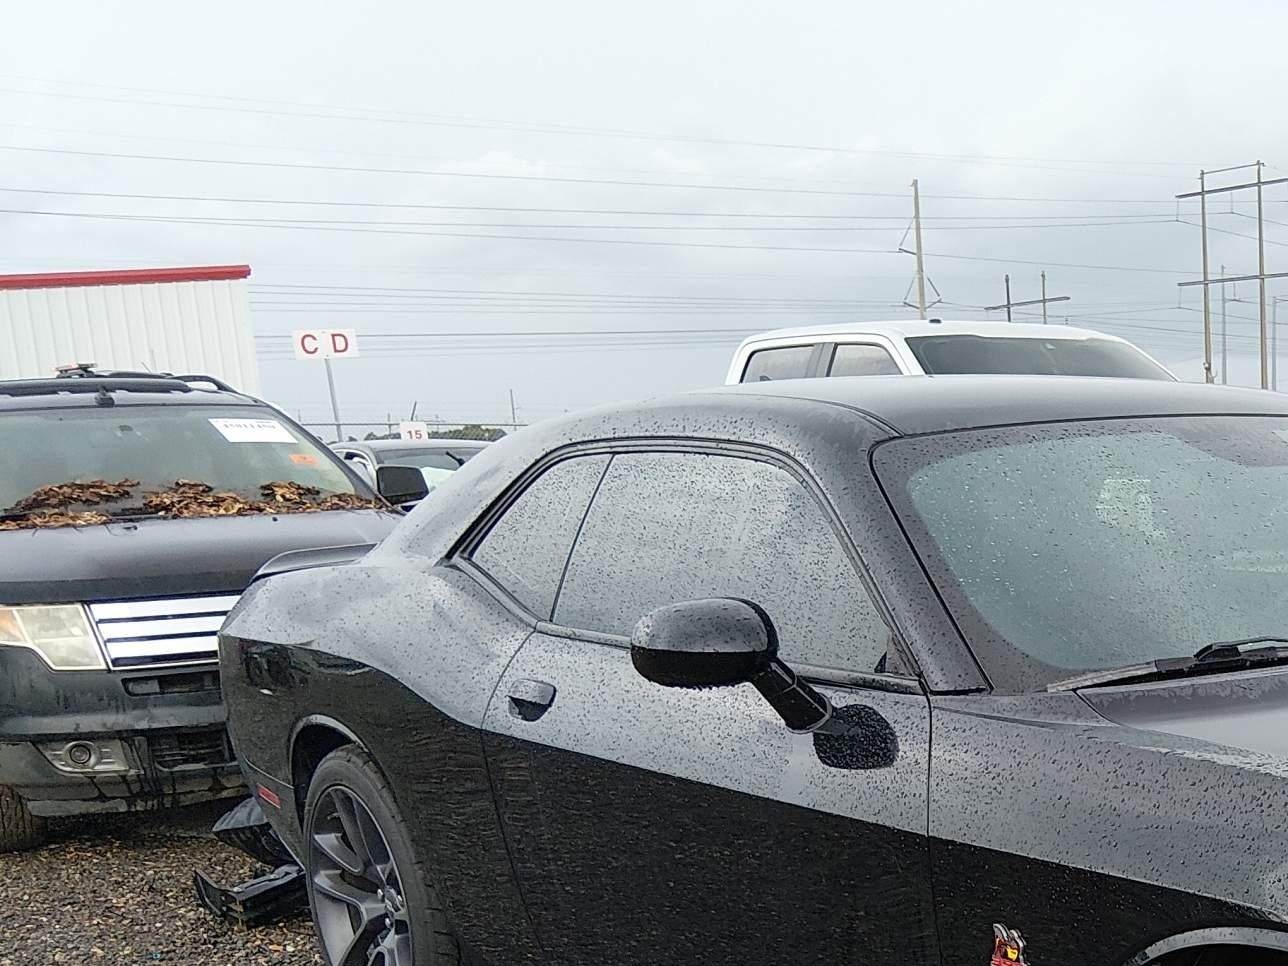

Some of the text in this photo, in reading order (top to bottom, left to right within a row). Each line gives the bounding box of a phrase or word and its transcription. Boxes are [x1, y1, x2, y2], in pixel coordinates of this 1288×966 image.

[301, 333, 349, 355] C D
[407, 430, 422, 440] 15
